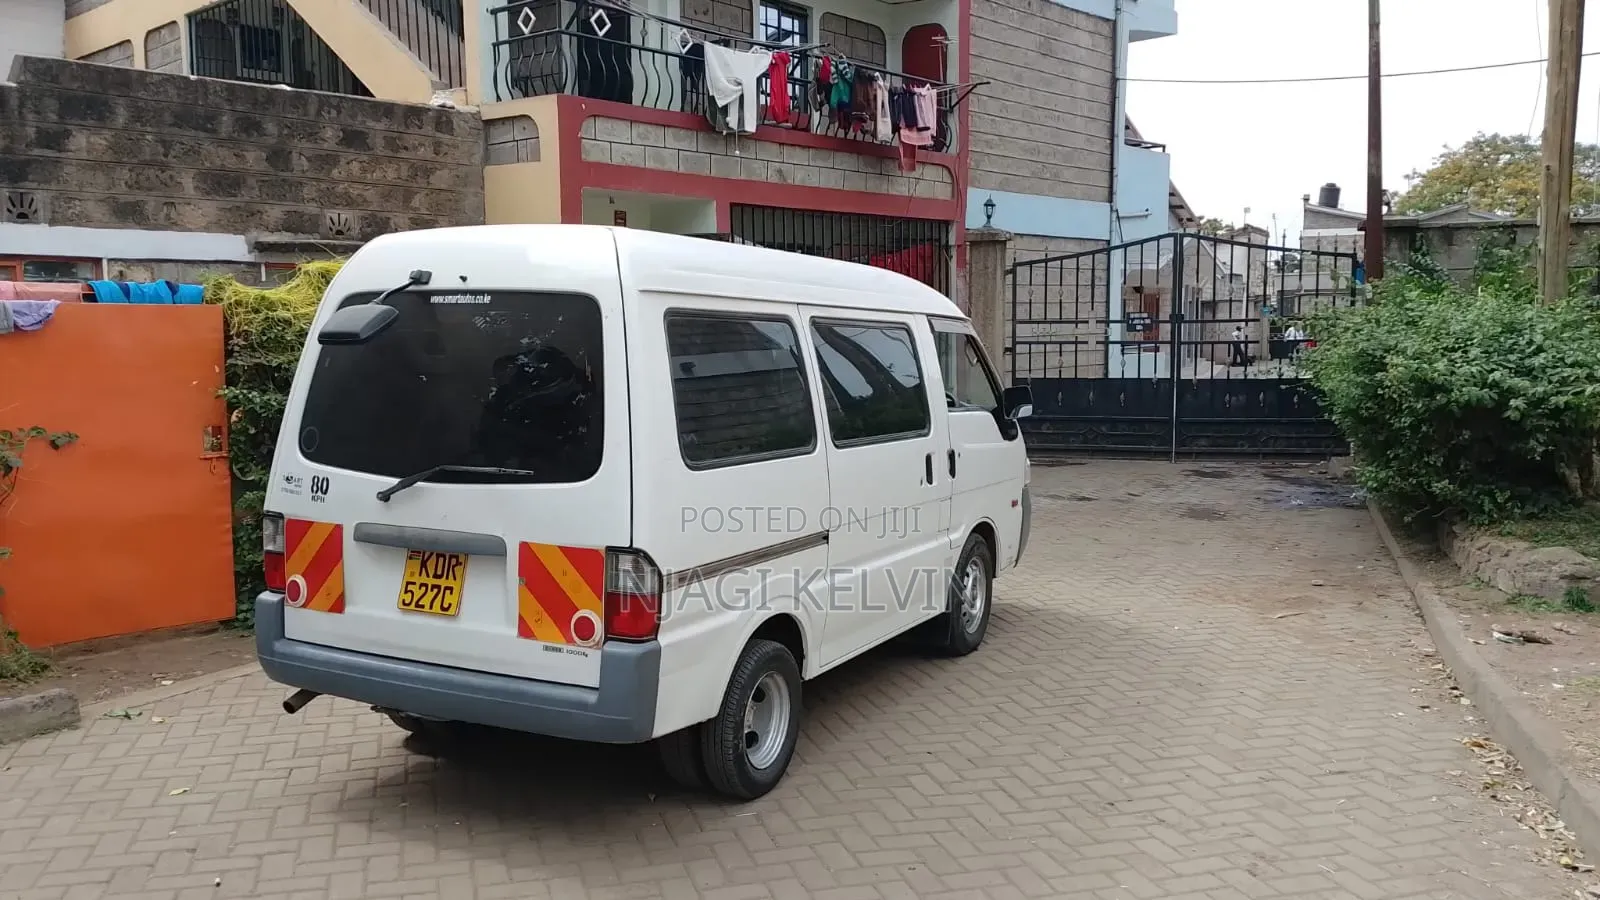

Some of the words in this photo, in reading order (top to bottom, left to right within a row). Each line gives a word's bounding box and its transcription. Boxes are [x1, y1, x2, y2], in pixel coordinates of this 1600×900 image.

[310, 475, 330, 495] 80
[311, 494, 326, 503] KPH
[418, 550, 462, 581] KDR
[402, 581, 454, 612] 527C
